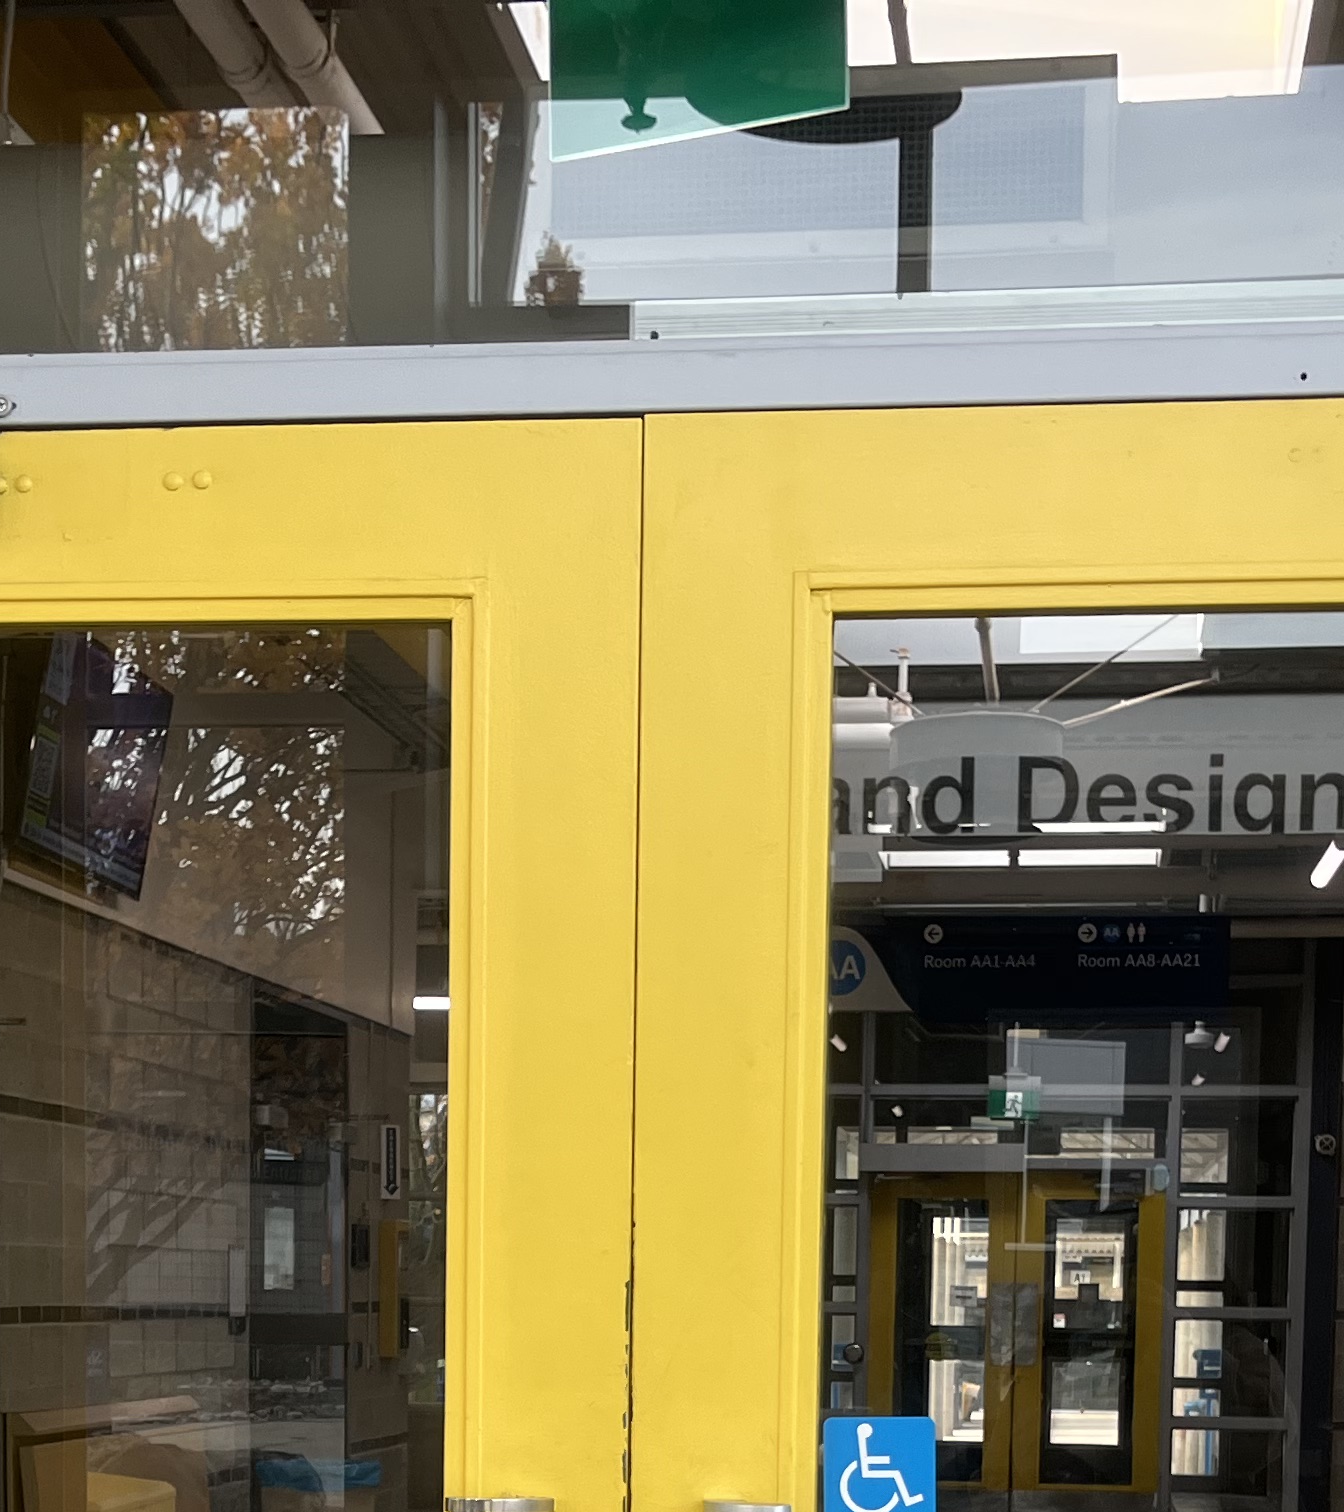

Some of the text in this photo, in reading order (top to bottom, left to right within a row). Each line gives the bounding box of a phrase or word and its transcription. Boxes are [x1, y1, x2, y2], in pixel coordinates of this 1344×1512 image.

[923, 954, 1036, 969] Room AA1-AA4
[1077, 953, 1201, 968] Room AA8-AA21
